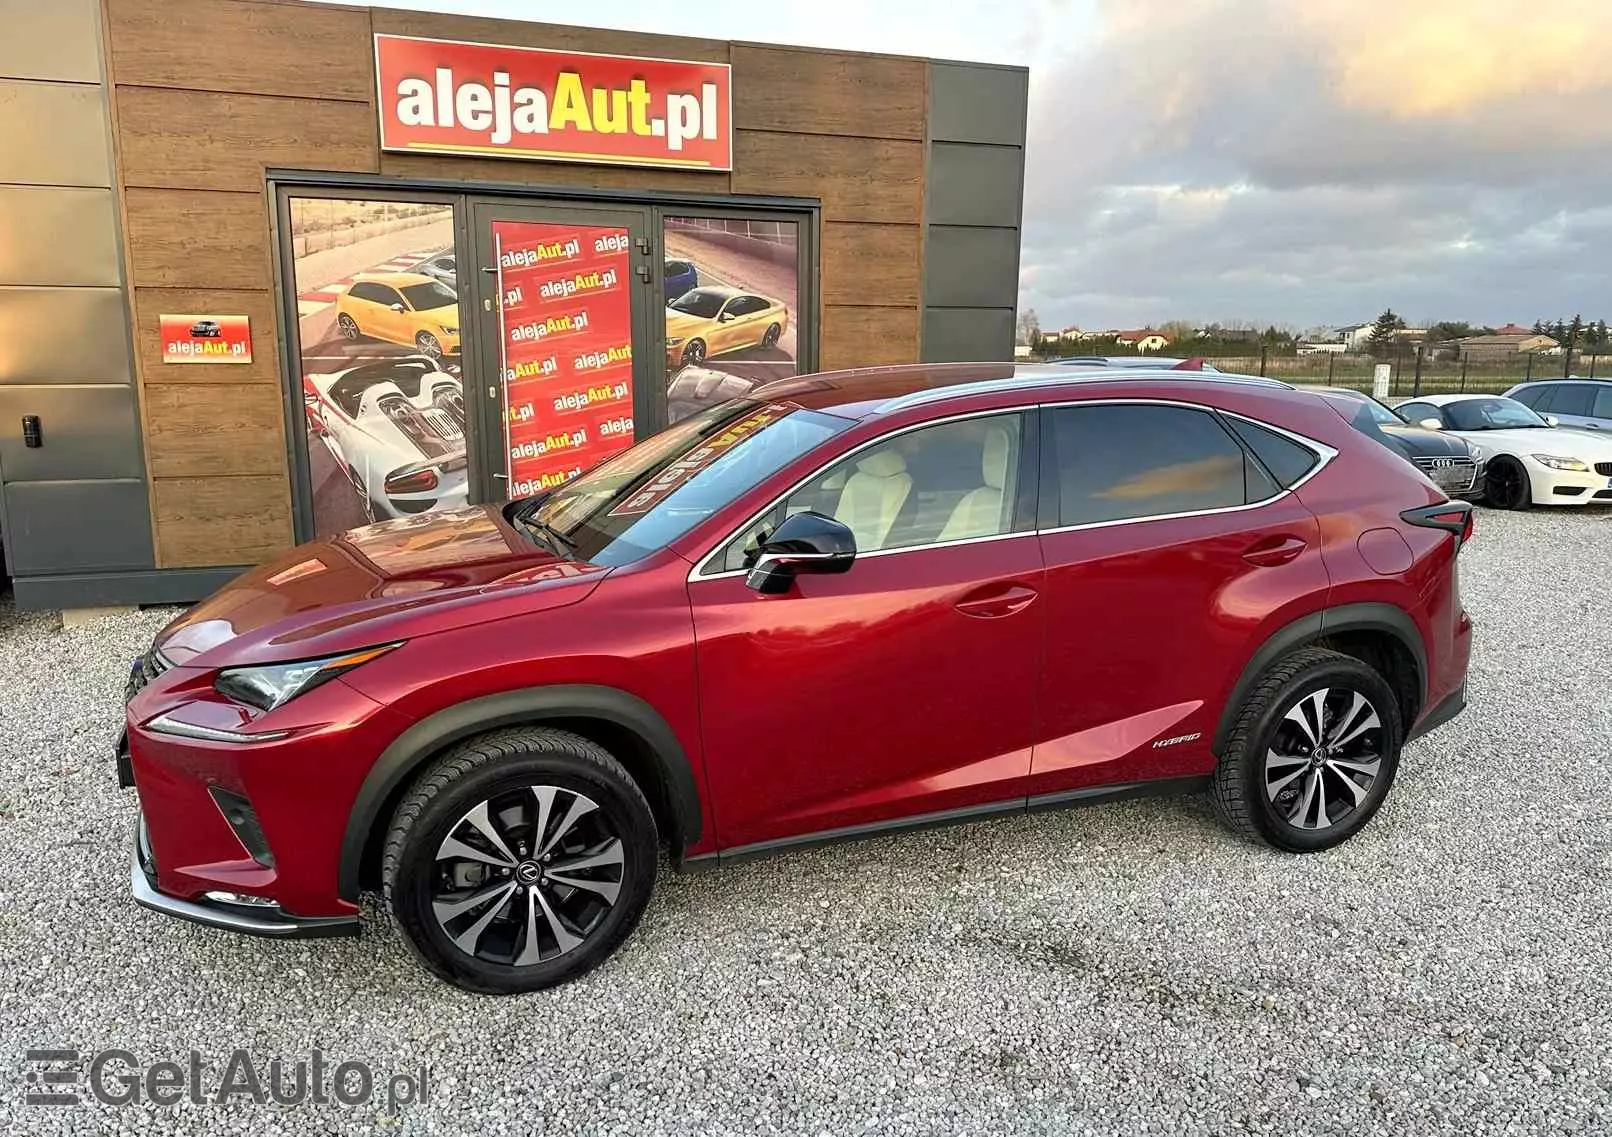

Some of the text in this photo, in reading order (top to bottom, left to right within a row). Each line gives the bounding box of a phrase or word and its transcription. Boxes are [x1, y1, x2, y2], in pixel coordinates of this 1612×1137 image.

[397, 68, 717, 150] alejaAut.pl
[501, 239, 580, 267] alejaAut.pl
[594, 233, 629, 252] aleja
[540, 269, 617, 298] alejaAut.pl
[511, 312, 588, 341] alejaAut.pl
[168, 341, 246, 357] alejaAut.pl
[554, 382, 628, 411] alejaAut.pl
[600, 417, 633, 436] aleja
[511, 429, 587, 458] alejaAut.pl
[1152, 732, 1202, 748] HYBRID
